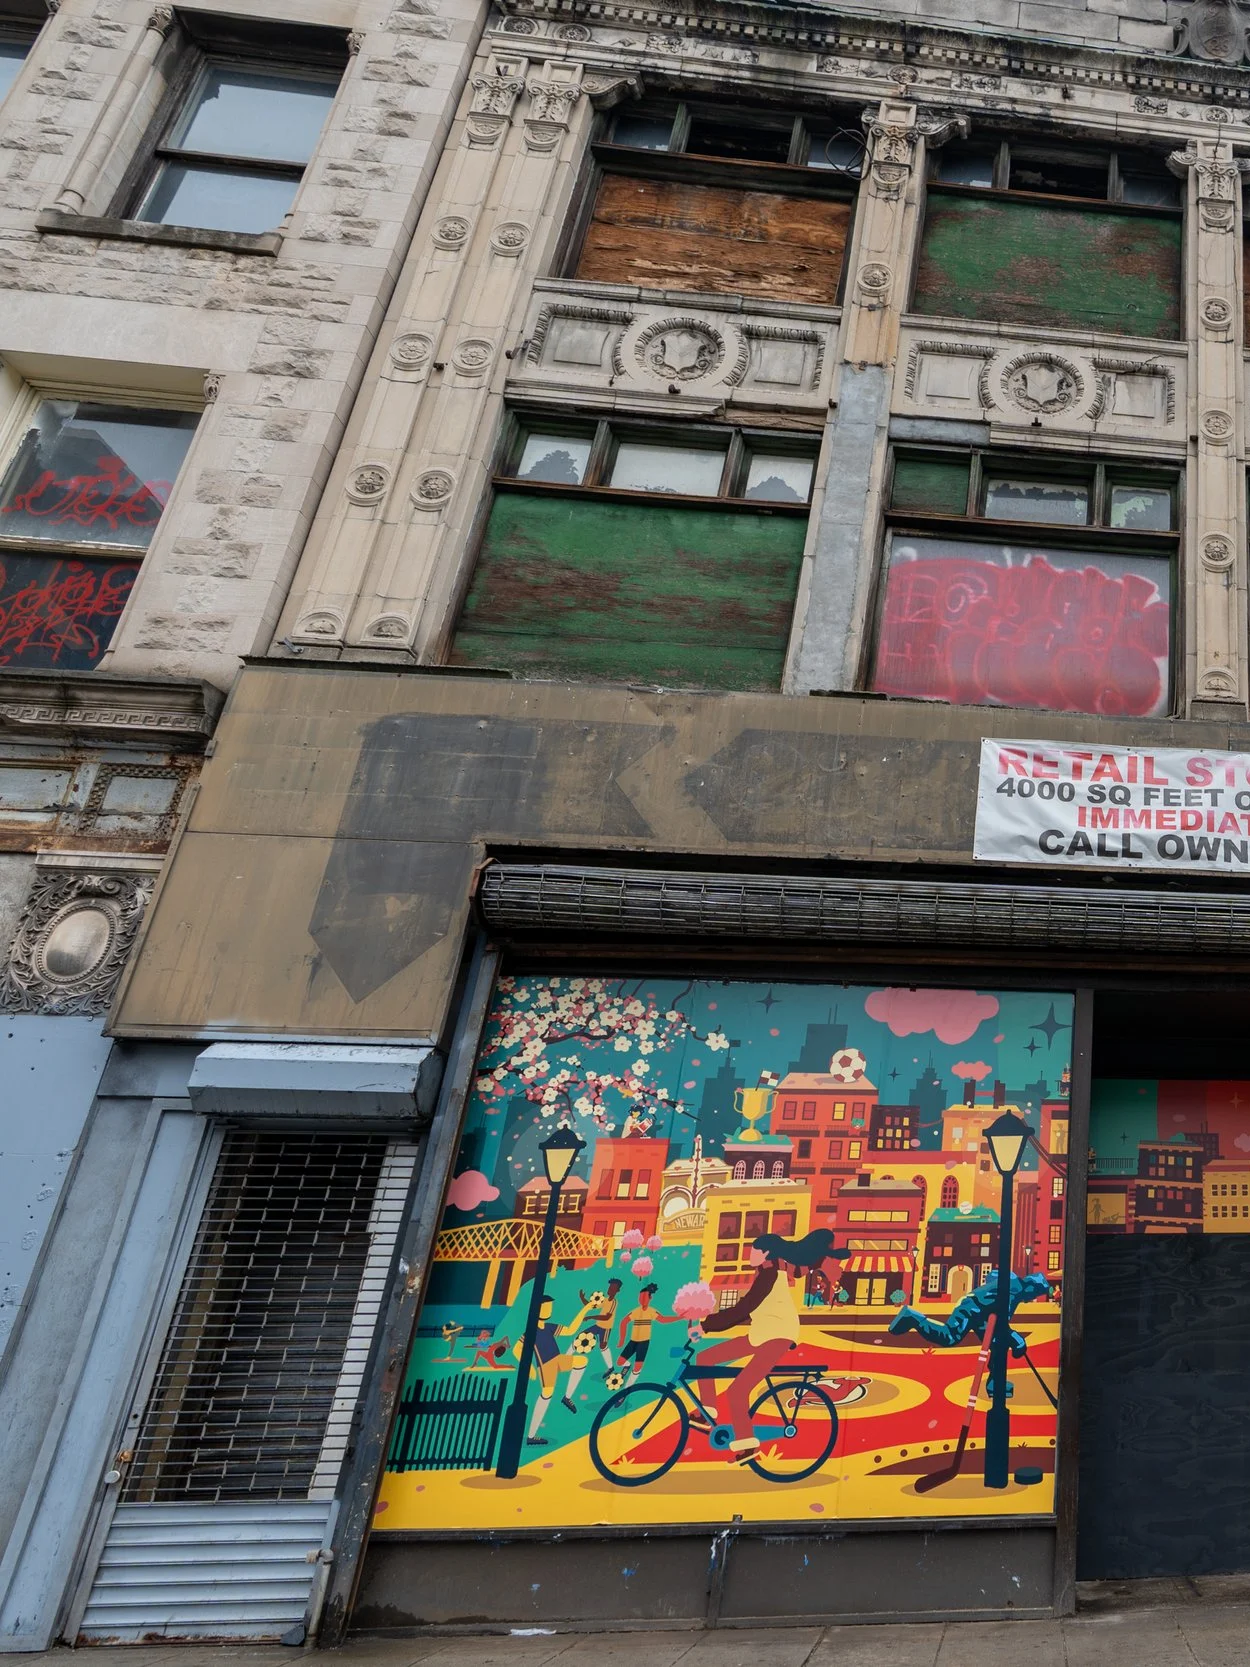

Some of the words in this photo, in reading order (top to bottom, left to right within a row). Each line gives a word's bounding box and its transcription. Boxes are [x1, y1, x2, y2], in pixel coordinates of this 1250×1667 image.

[998, 747, 1169, 786] RETAIL
[996, 776, 1076, 801] 4000
[1086, 783, 1132, 807] SQ
[1143, 787, 1225, 808] FEET
[1038, 828, 1143, 859] CALL
